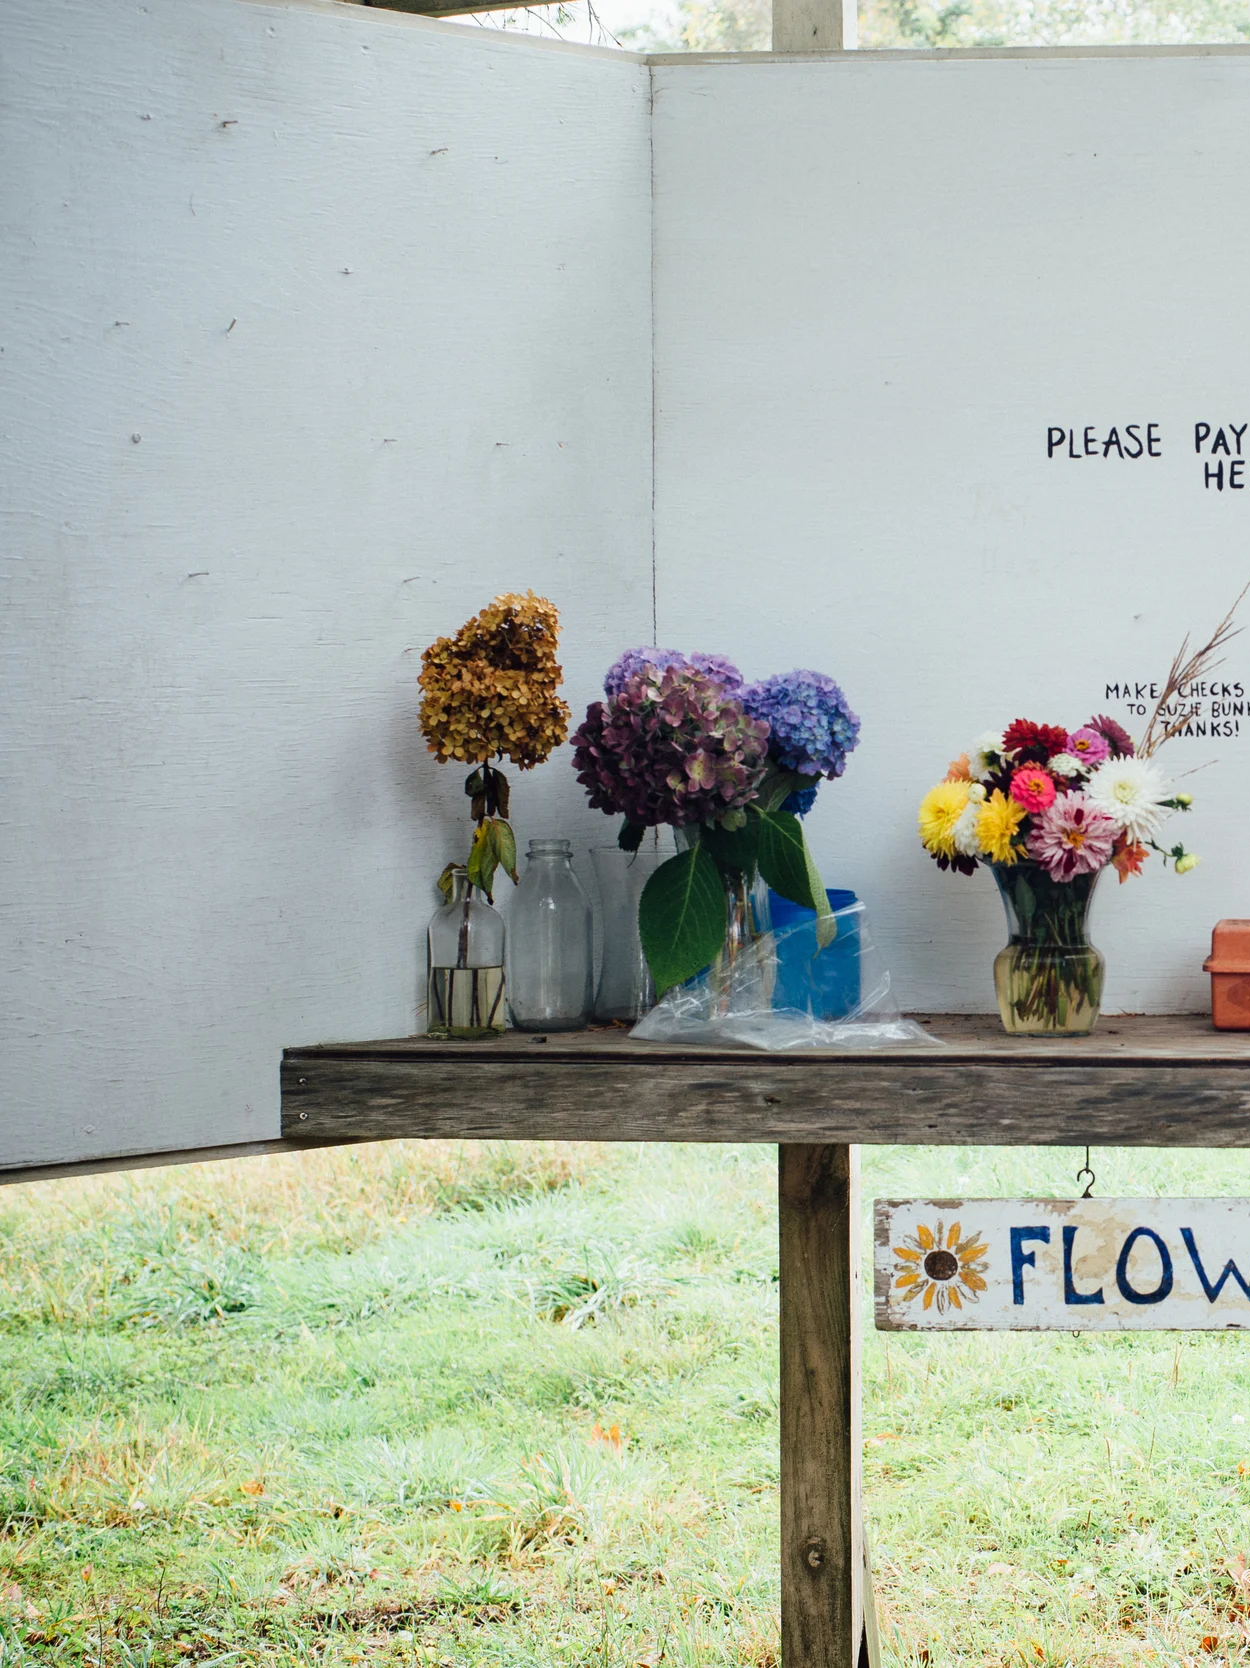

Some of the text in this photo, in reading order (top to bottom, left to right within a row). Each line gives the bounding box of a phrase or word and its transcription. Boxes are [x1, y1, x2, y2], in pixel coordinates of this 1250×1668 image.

[1047, 423, 1162, 459] PLEASE
[1195, 421, 1248, 455] PAY
[1105, 682, 1161, 700] MAKE
[1177, 681, 1245, 698] CHECKS
[1127, 703, 1147, 716] TO
